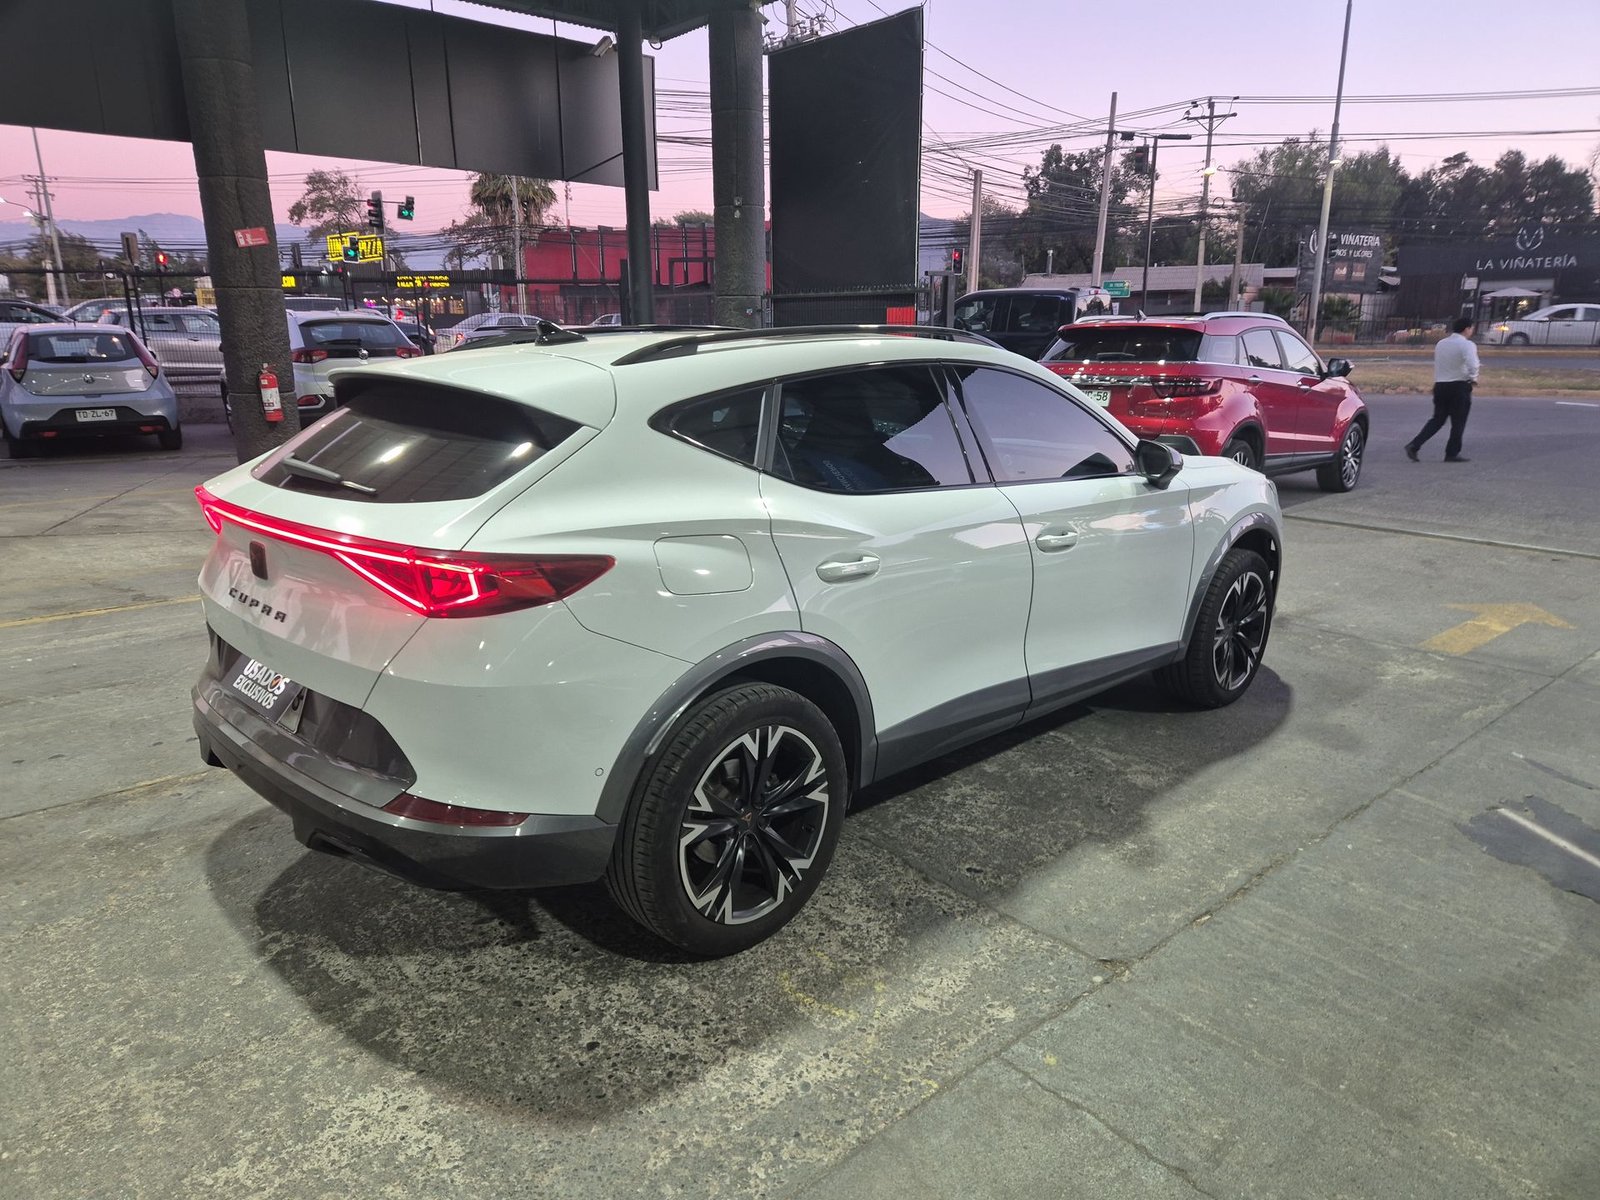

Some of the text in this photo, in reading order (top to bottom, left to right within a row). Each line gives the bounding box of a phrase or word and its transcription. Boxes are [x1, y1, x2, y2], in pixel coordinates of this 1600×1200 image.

[1476, 254, 1577, 270] LA VIÑATERÍA
[229, 587, 287, 623] CUPRA
[232, 674, 278, 709] EXCLUSIVOS
[243, 659, 291, 695] USADOS
